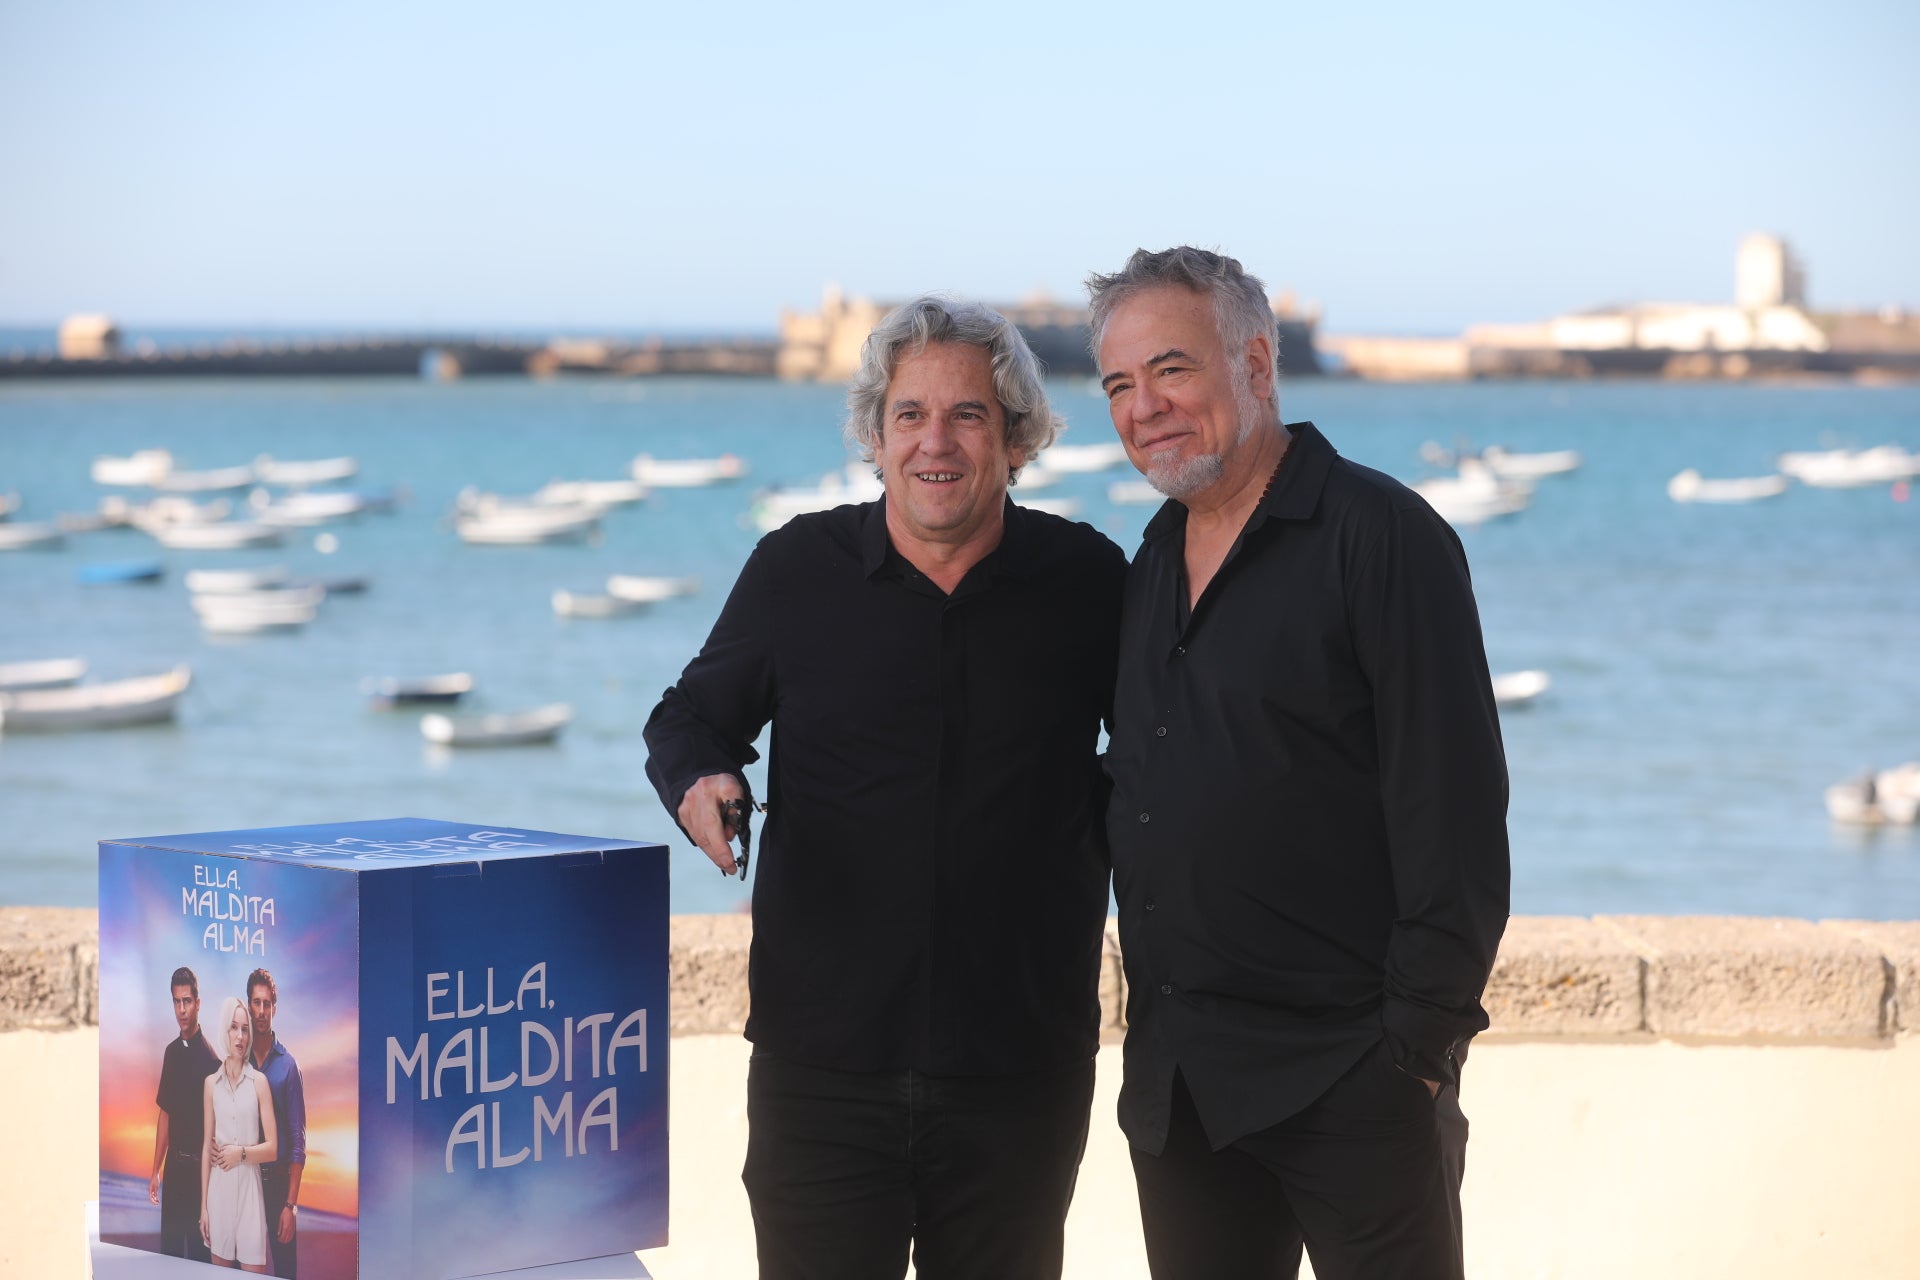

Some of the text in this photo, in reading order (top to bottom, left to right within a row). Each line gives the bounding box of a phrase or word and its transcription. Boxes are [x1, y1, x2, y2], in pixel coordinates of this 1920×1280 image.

[231, 831, 525, 858] MALDITA
[353, 841, 546, 861] ALMA
[194, 864, 241, 891] ELLA,
[182, 887, 275, 926] MALDITA
[203, 922, 265, 957] ALMA
[427, 961, 555, 1022] ELLA,
[386, 1008, 648, 1104] MALDITA
[445, 1086, 619, 1173] ALMA
